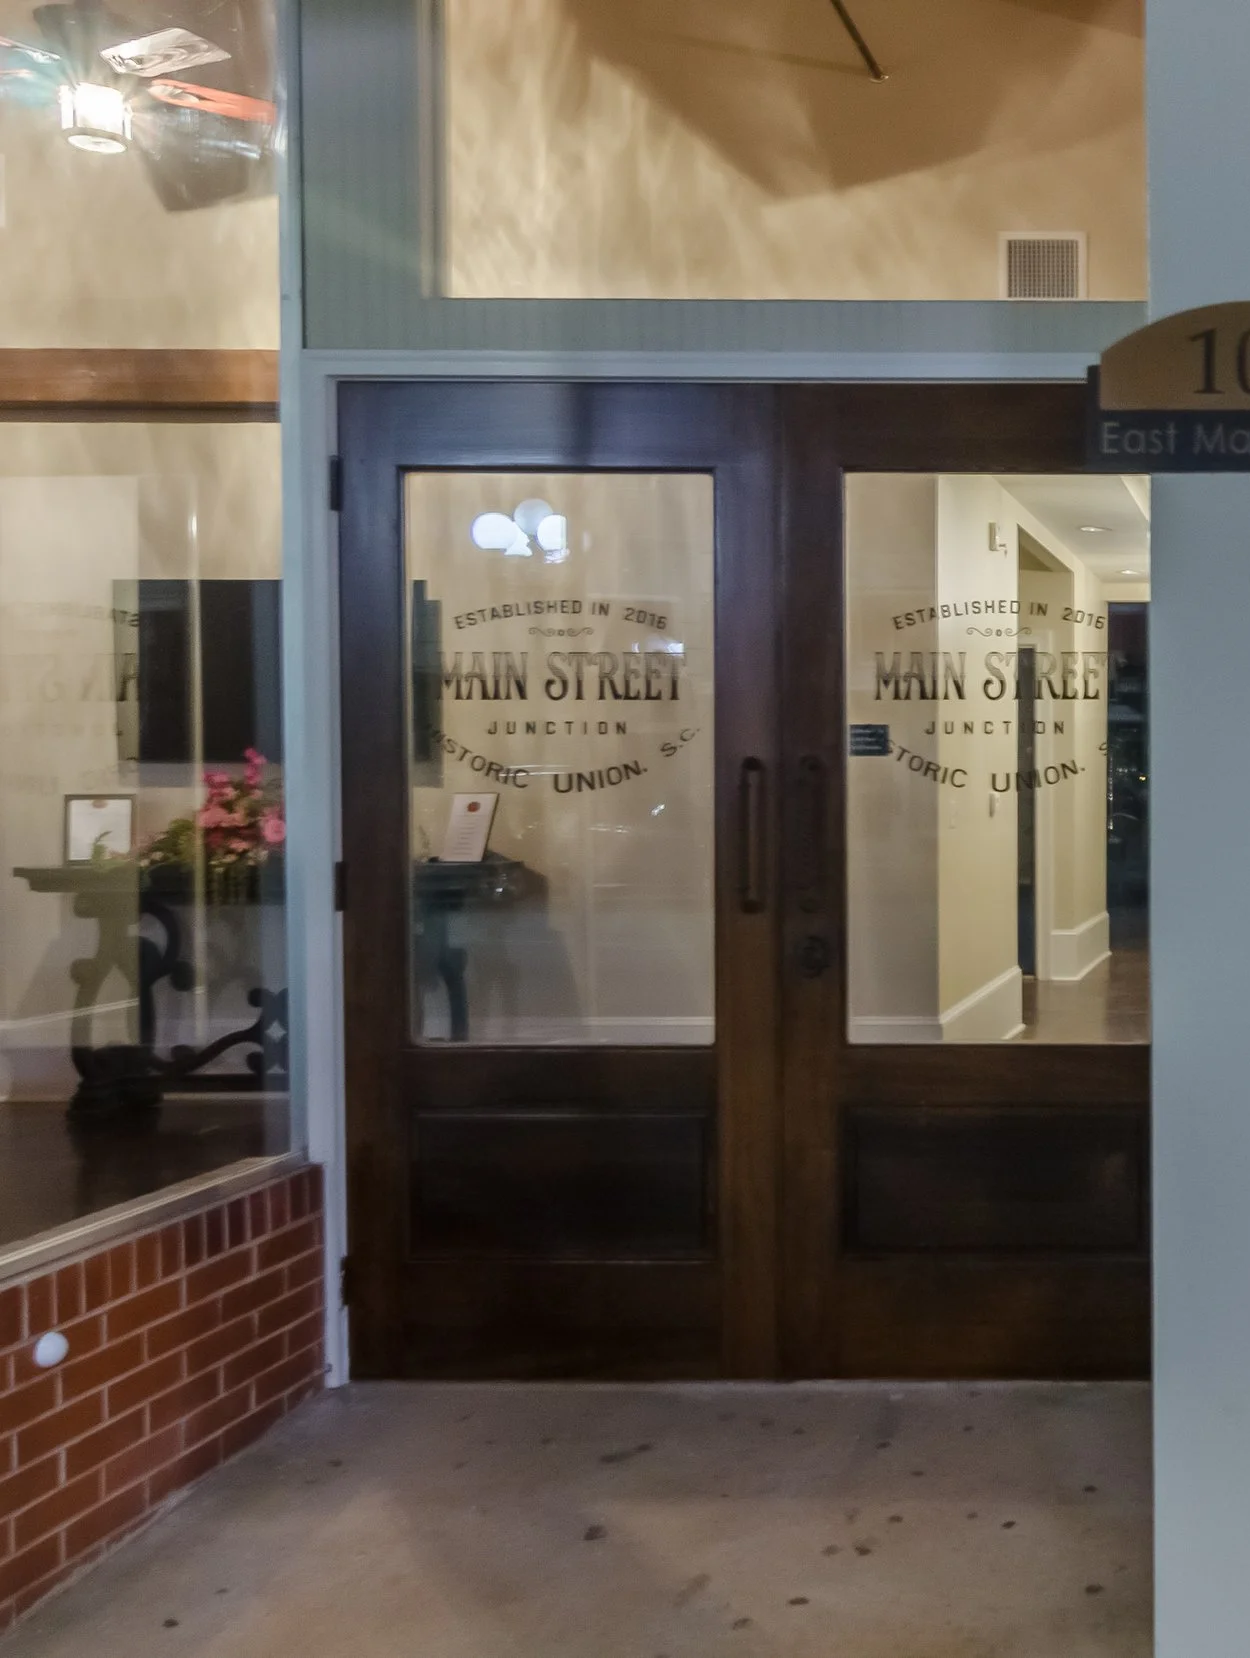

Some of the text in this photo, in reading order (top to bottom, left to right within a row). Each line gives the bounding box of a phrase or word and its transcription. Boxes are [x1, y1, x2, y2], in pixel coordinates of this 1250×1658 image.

[1101, 421, 1177, 455] East
[454, 600, 668, 630] ESTABLISHED IN 2016
[892, 600, 1106, 630] ESTABLISHED IN 2016
[437, 651, 687, 701] MAIN STREET
[874, 651, 966, 701] MAIN
[487, 720, 628, 736] JUNCTION
